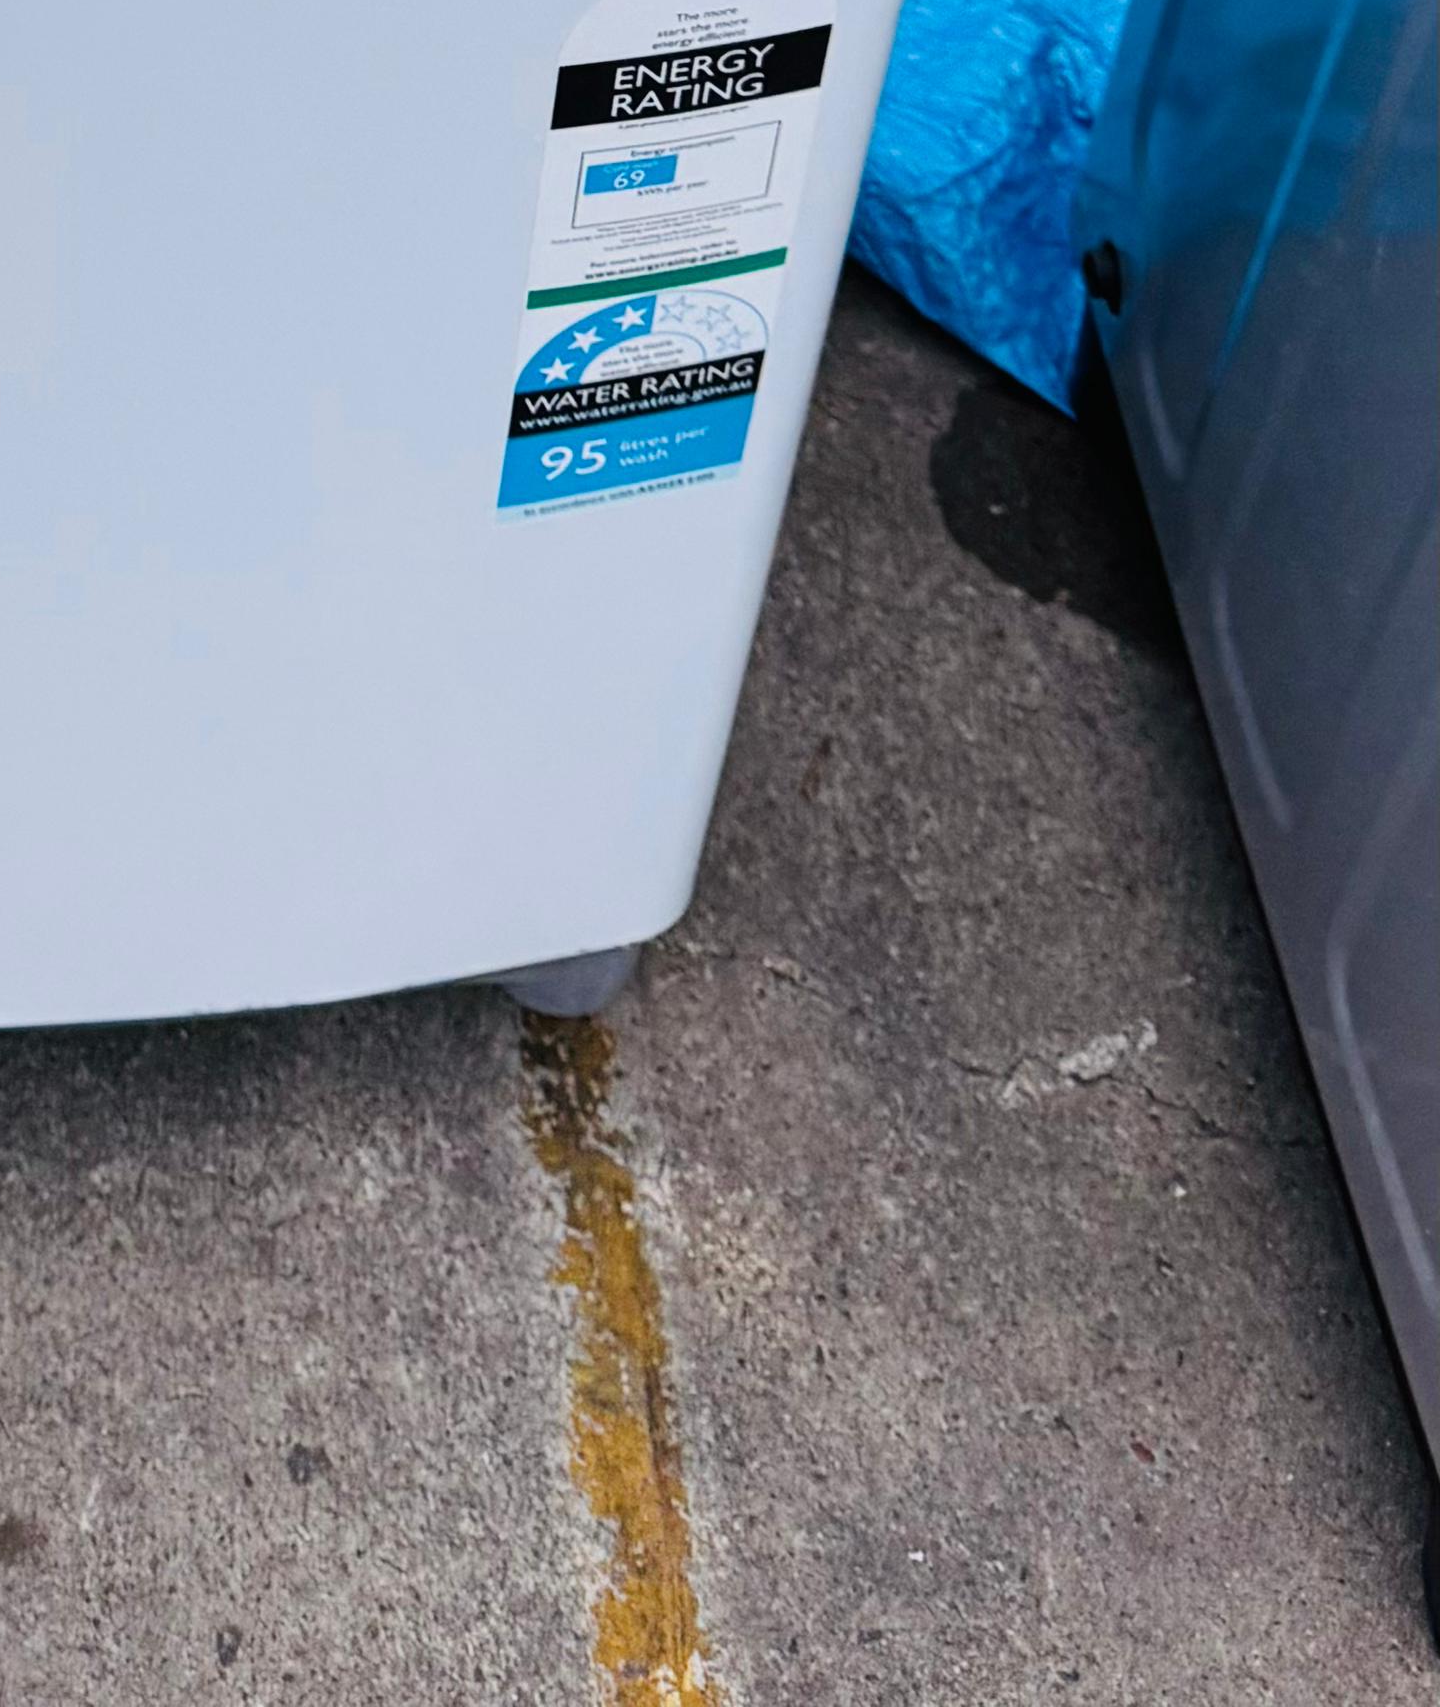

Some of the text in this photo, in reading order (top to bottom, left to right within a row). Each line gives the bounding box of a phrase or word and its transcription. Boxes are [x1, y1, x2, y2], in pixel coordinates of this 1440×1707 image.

[657, 17, 749, 37] stars the more
[676, 7, 738, 23] The more
[652, 29, 747, 50] energy efficient
[613, 43, 775, 90] ENERGY
[610, 72, 765, 117] RATING
[630, 147, 666, 158] Energy
[613, 169, 646, 189] 69
[524, 357, 755, 415] WATER RATING
[519, 378, 753, 430] www.waterrating.gov.au
[619, 425, 709, 453] litres per
[541, 438, 608, 481] 95
[619, 449, 669, 467] wash
